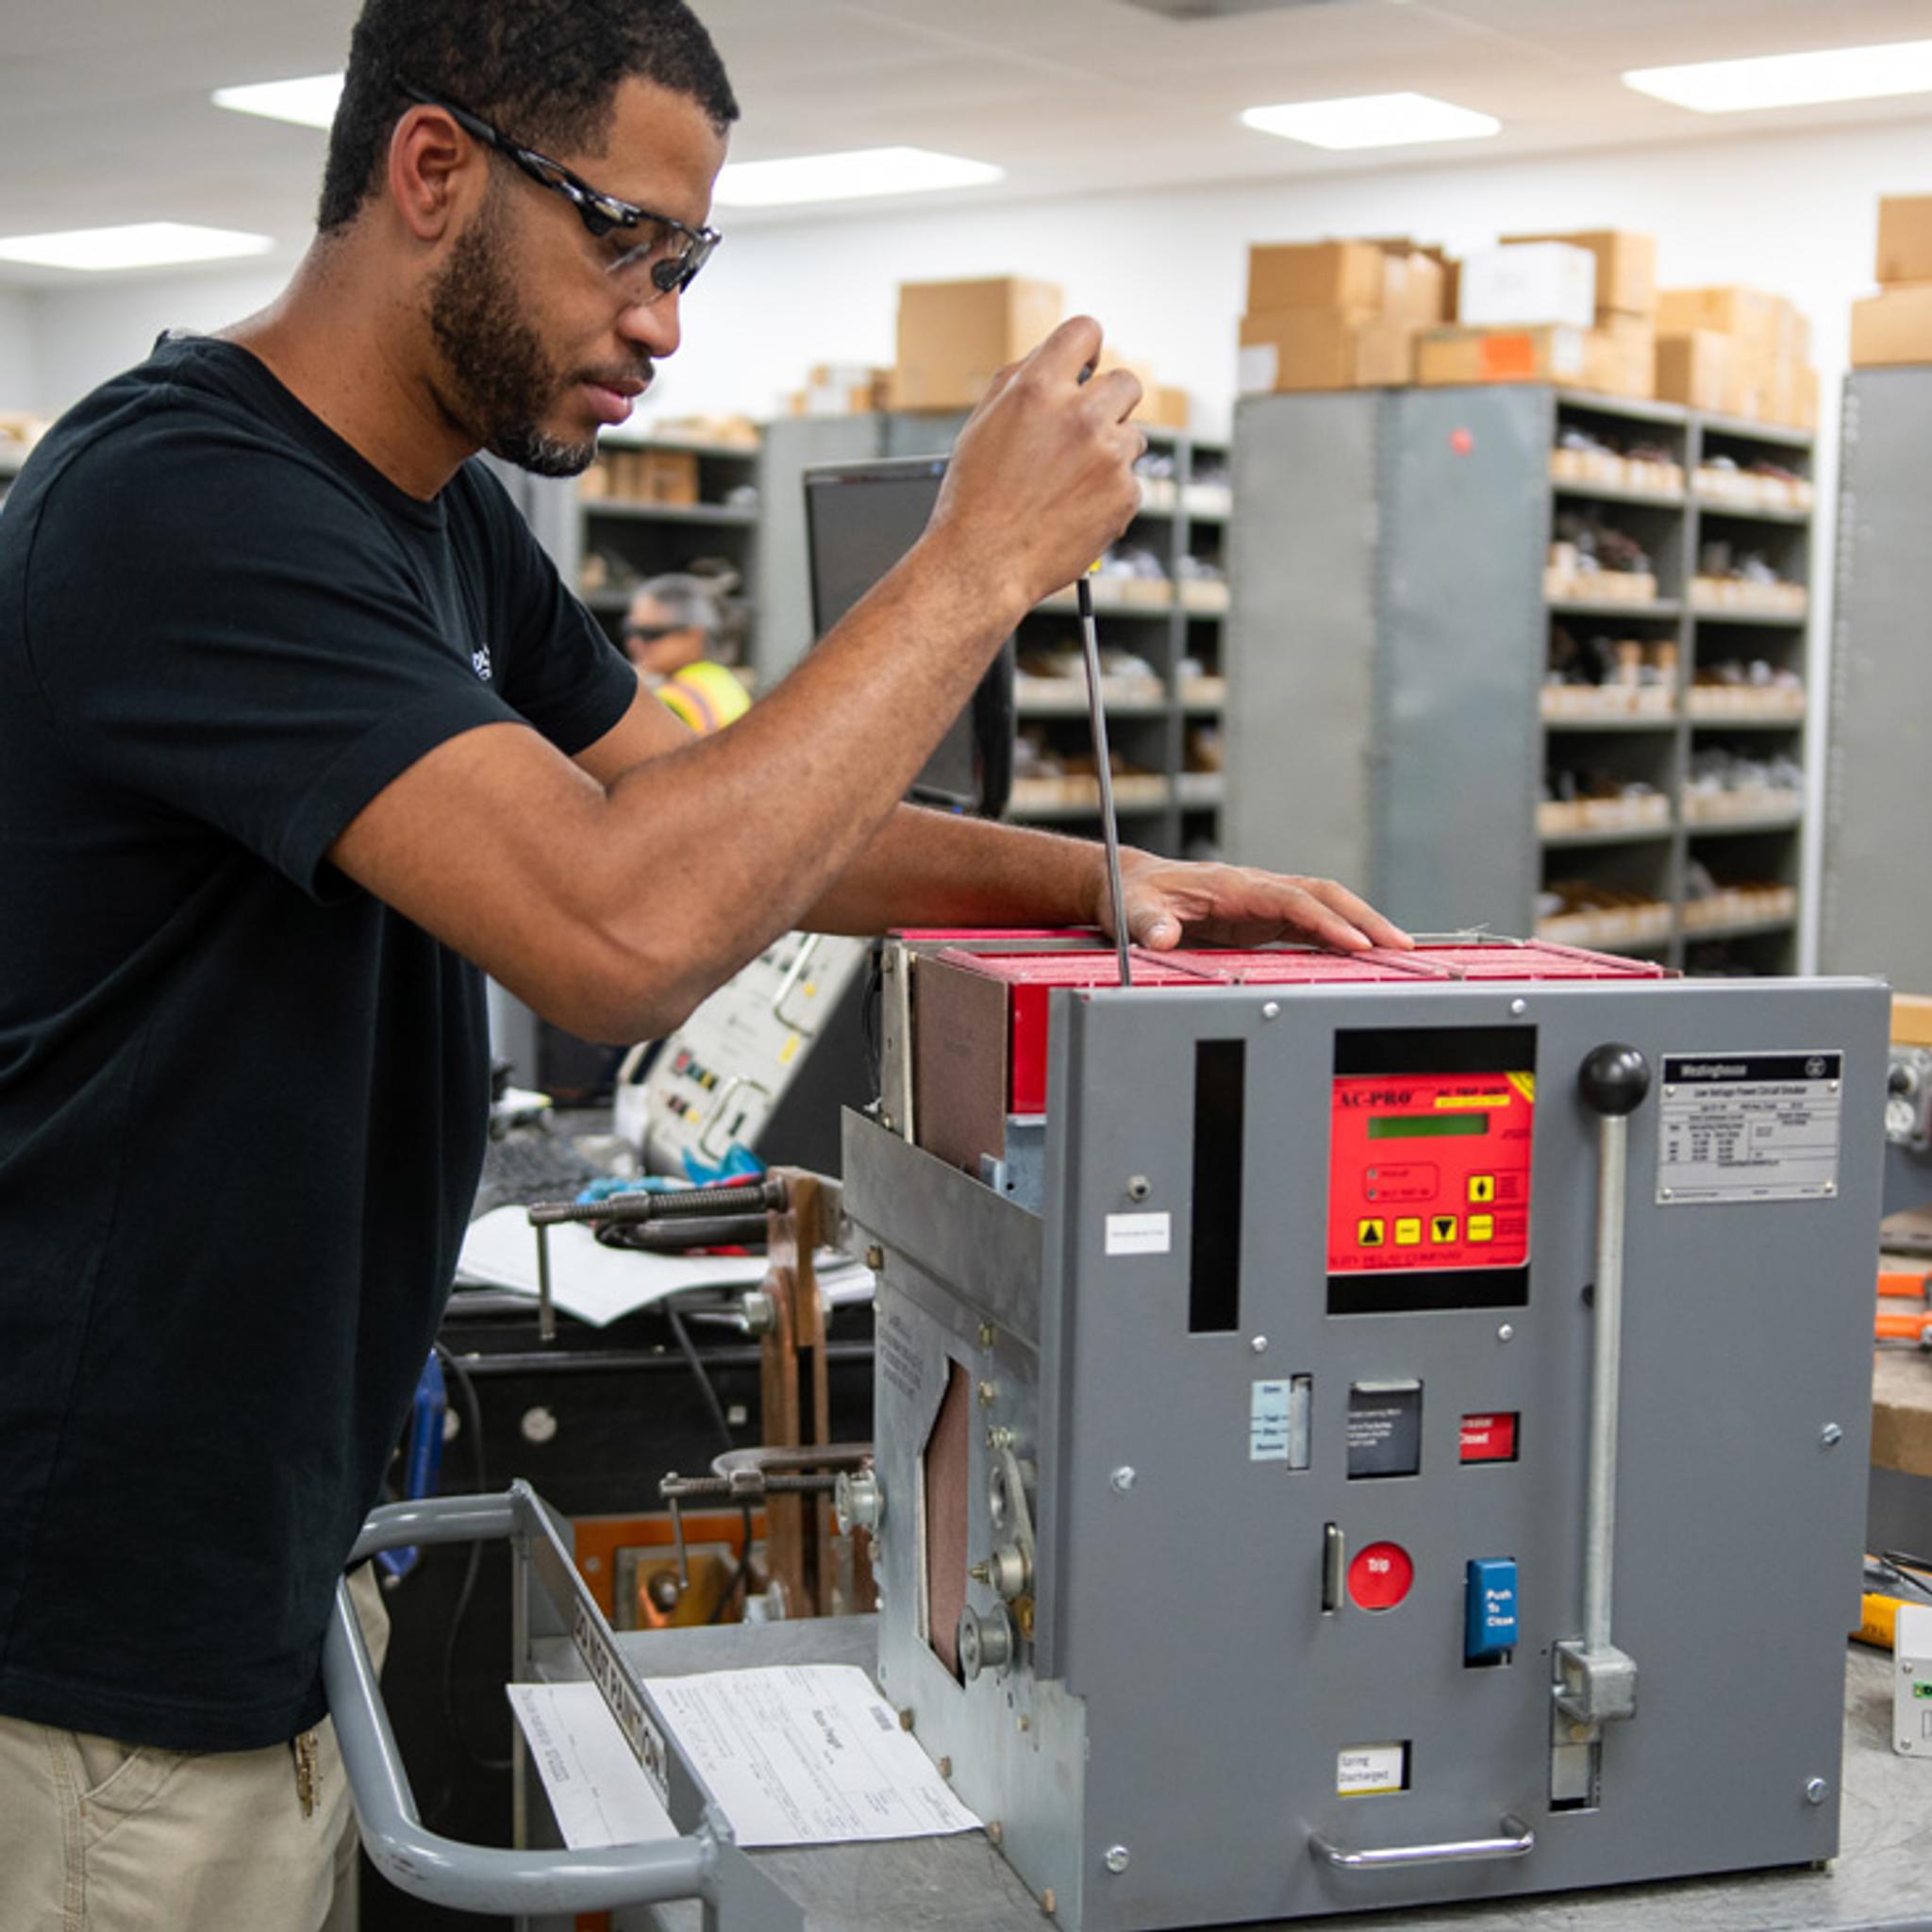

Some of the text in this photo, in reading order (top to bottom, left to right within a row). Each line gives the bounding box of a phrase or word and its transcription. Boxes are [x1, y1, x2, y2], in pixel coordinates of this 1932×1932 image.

[1342, 1091, 1412, 1107] AC-PRO
[1368, 1557, 1391, 1574] Trip
[1487, 1590, 1512, 1601] Push
[1488, 1603, 1500, 1613] To
[1487, 1616, 1514, 1627] Close
